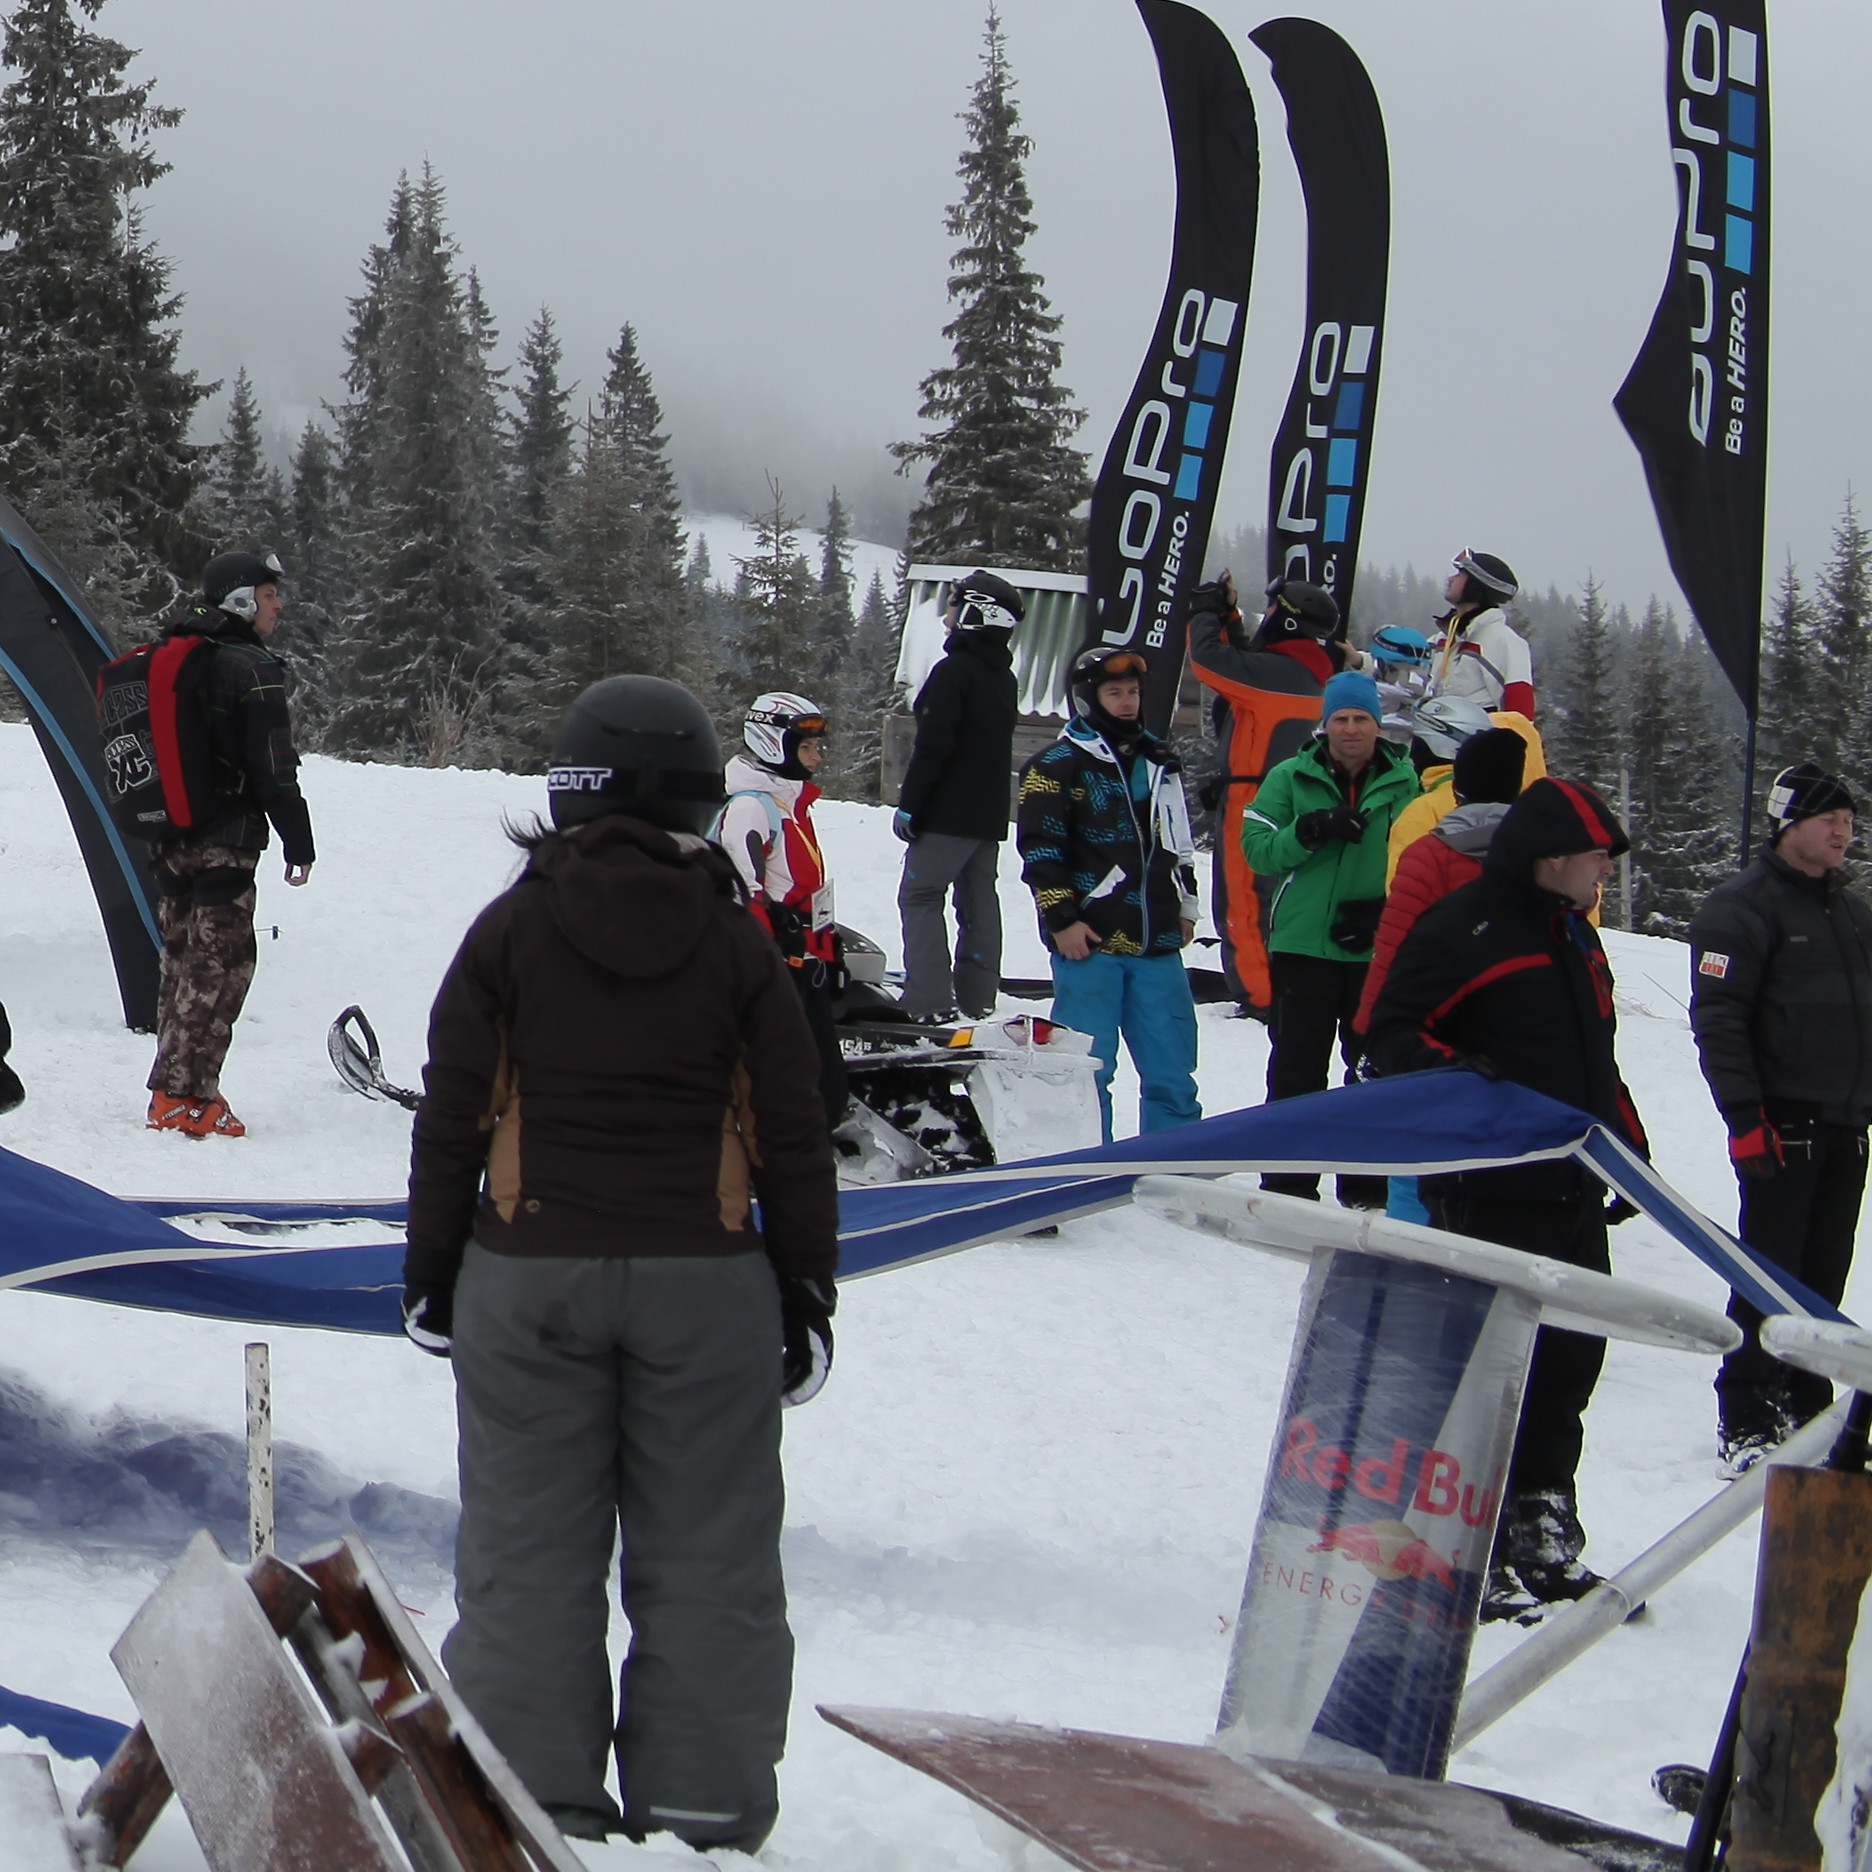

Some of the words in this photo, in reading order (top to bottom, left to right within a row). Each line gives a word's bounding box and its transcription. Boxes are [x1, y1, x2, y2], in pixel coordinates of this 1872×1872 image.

[1726, 286, 1748, 392] HERO.
[1730, 395, 1746, 414] a
[1276, 321, 1342, 583] oPro
[1725, 419, 1744, 456] Be
[1157, 510, 1190, 600] HERO.
[1158, 601, 1173, 624] a
[1145, 623, 1168, 650] Be
[548, 766, 614, 791] COTT
[1281, 1417, 1410, 1505] Red
